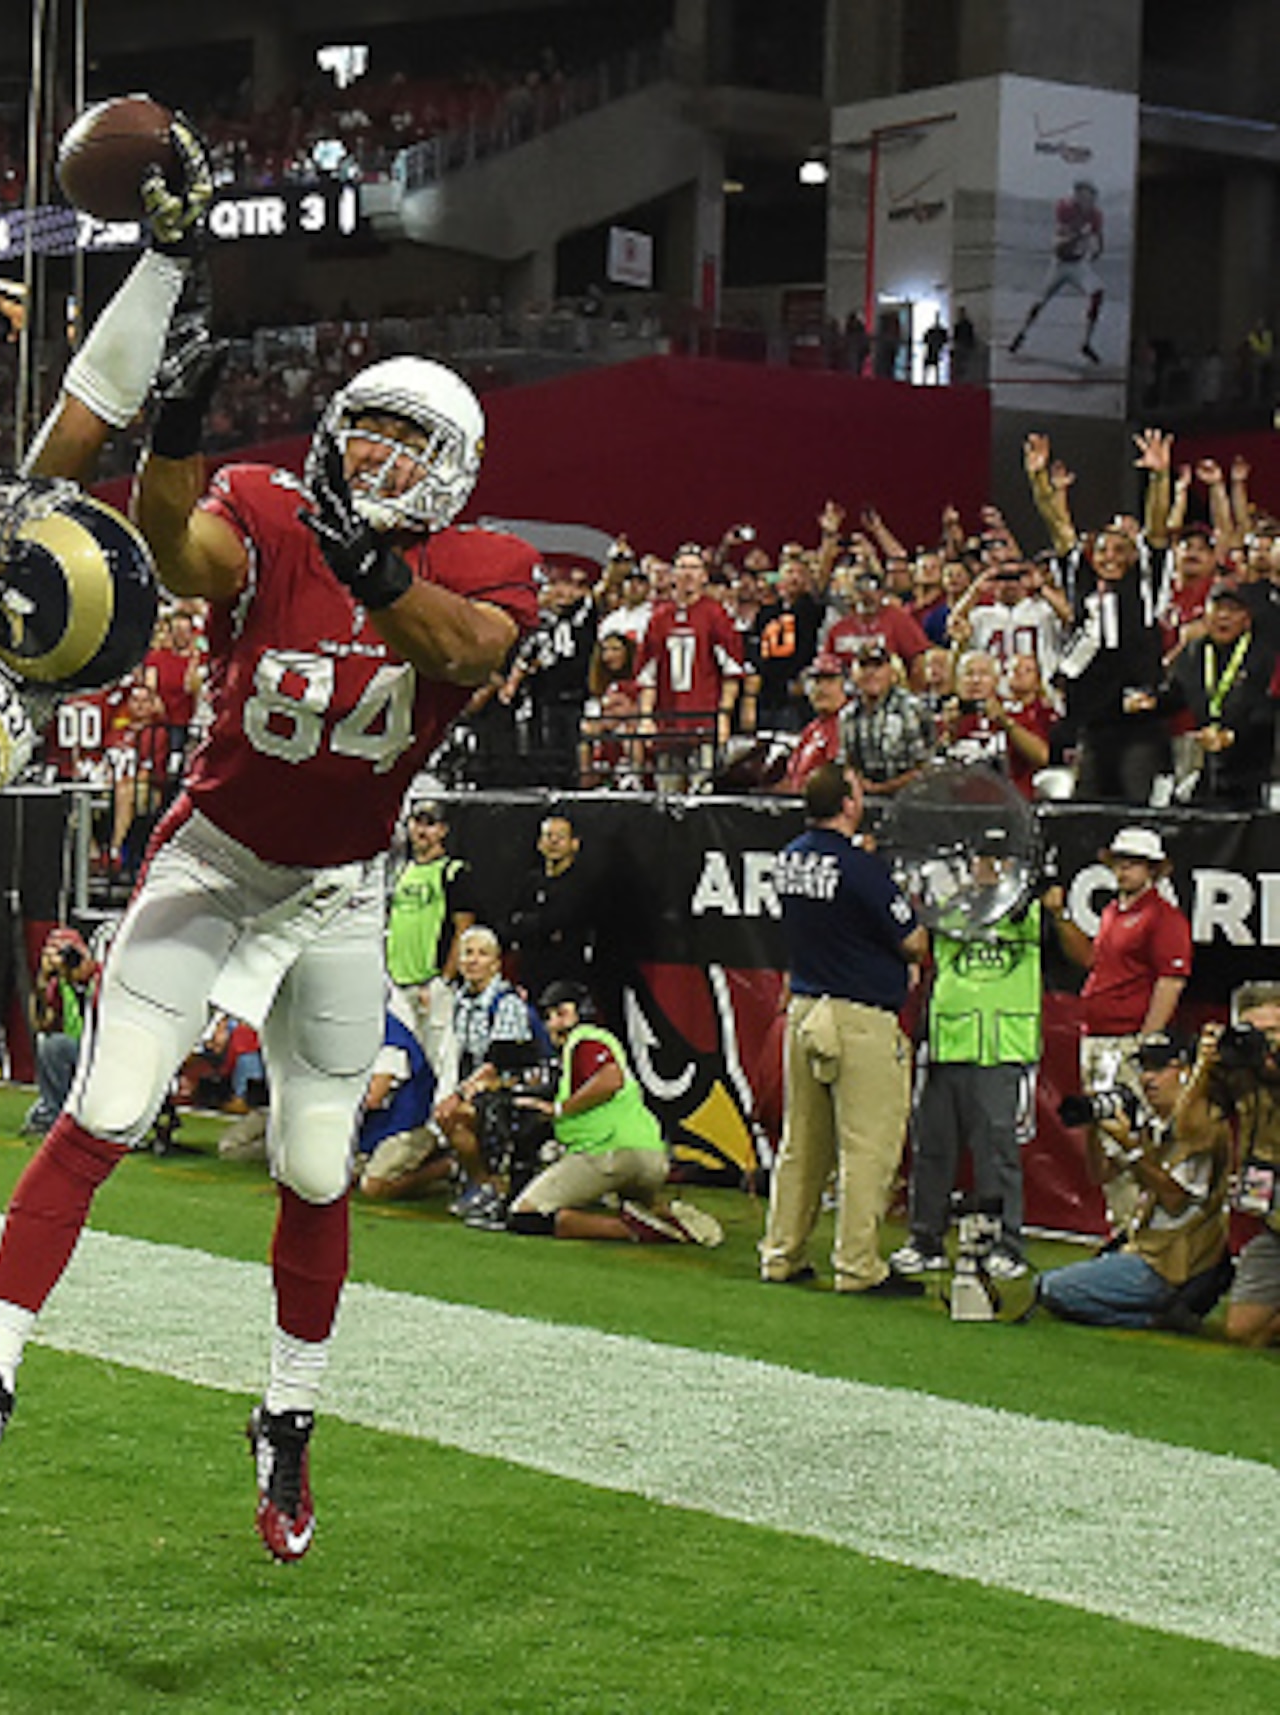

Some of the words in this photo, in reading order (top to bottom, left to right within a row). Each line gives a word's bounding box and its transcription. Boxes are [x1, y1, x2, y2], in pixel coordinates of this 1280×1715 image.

[209, 196, 286, 239] QTR
[299, 193, 326, 231] 3
[243, 650, 417, 774] 84
